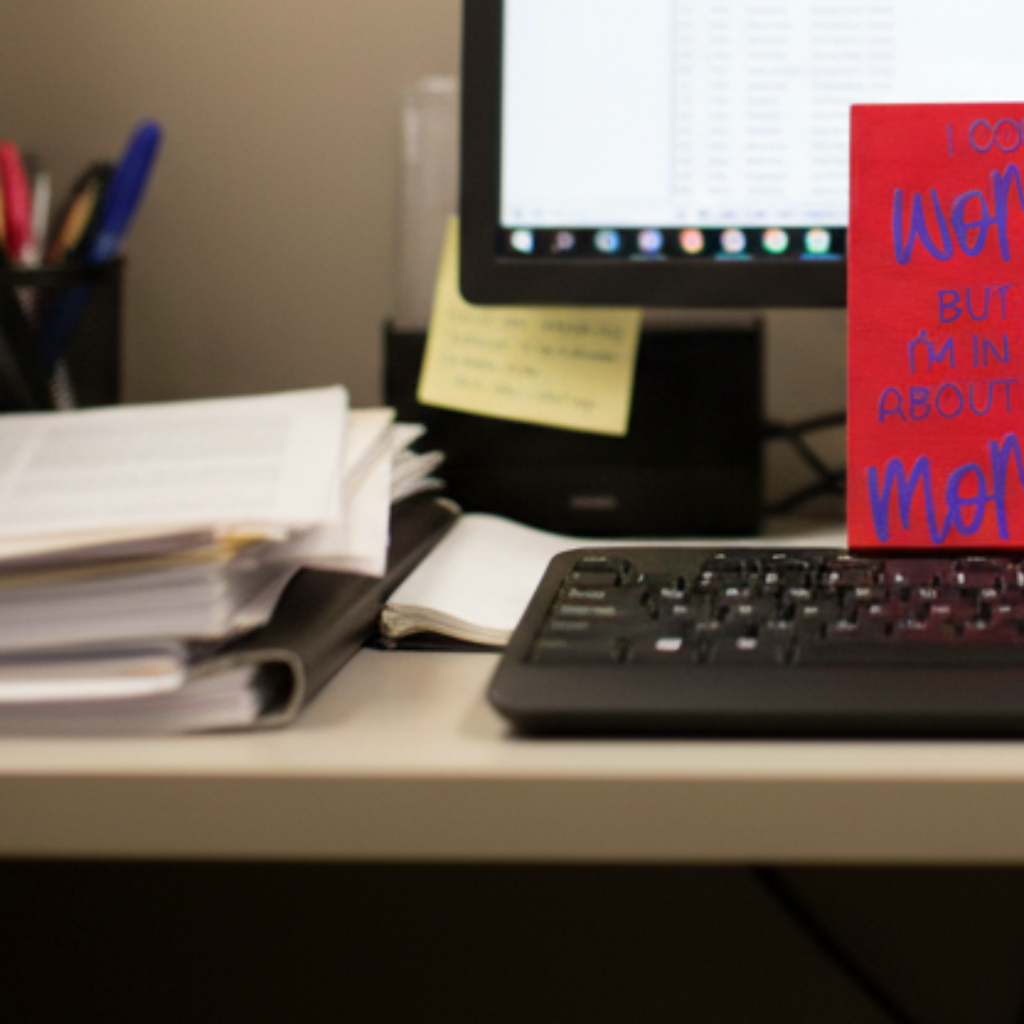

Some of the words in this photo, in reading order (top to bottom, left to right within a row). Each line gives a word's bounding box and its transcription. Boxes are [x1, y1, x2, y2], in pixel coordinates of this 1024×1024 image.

[947, 123, 953, 156] I
[938, 284, 1012, 323] BUT
[973, 333, 1010, 367] IN
[878, 378, 1019, 423] ABOUT
